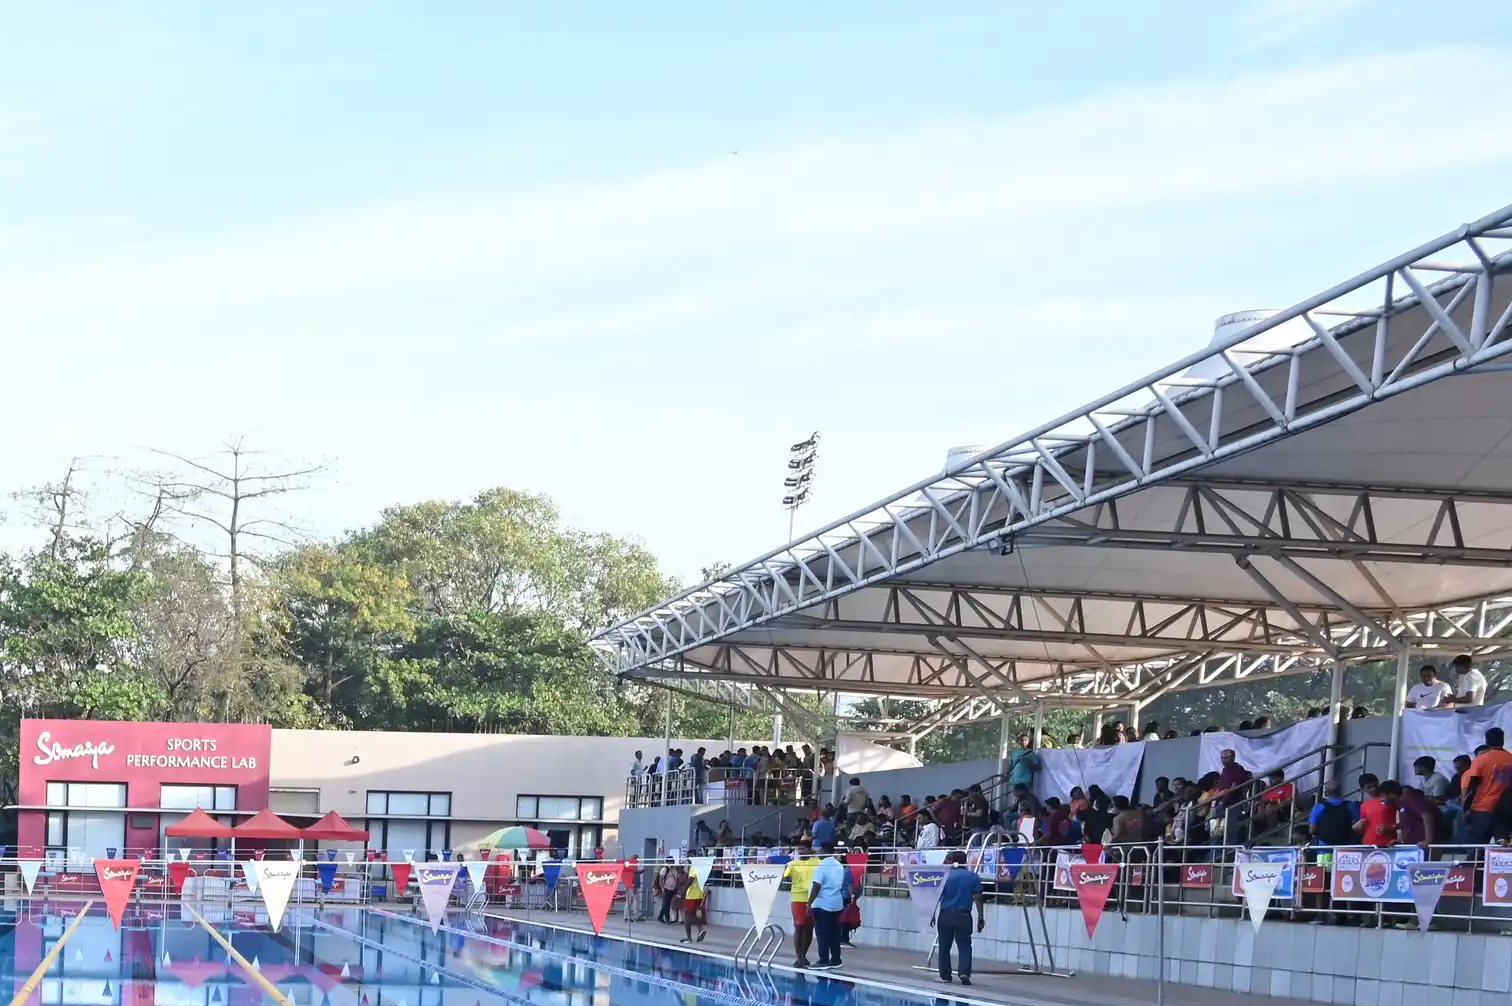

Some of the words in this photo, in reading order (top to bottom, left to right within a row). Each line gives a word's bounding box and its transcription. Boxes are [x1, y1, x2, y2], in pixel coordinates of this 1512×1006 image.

[33, 731, 115, 770] Somaiya
[167, 738, 217, 752] SPORTS
[126, 754, 228, 769] PERFORMANCE
[231, 756, 257, 769] LAB
